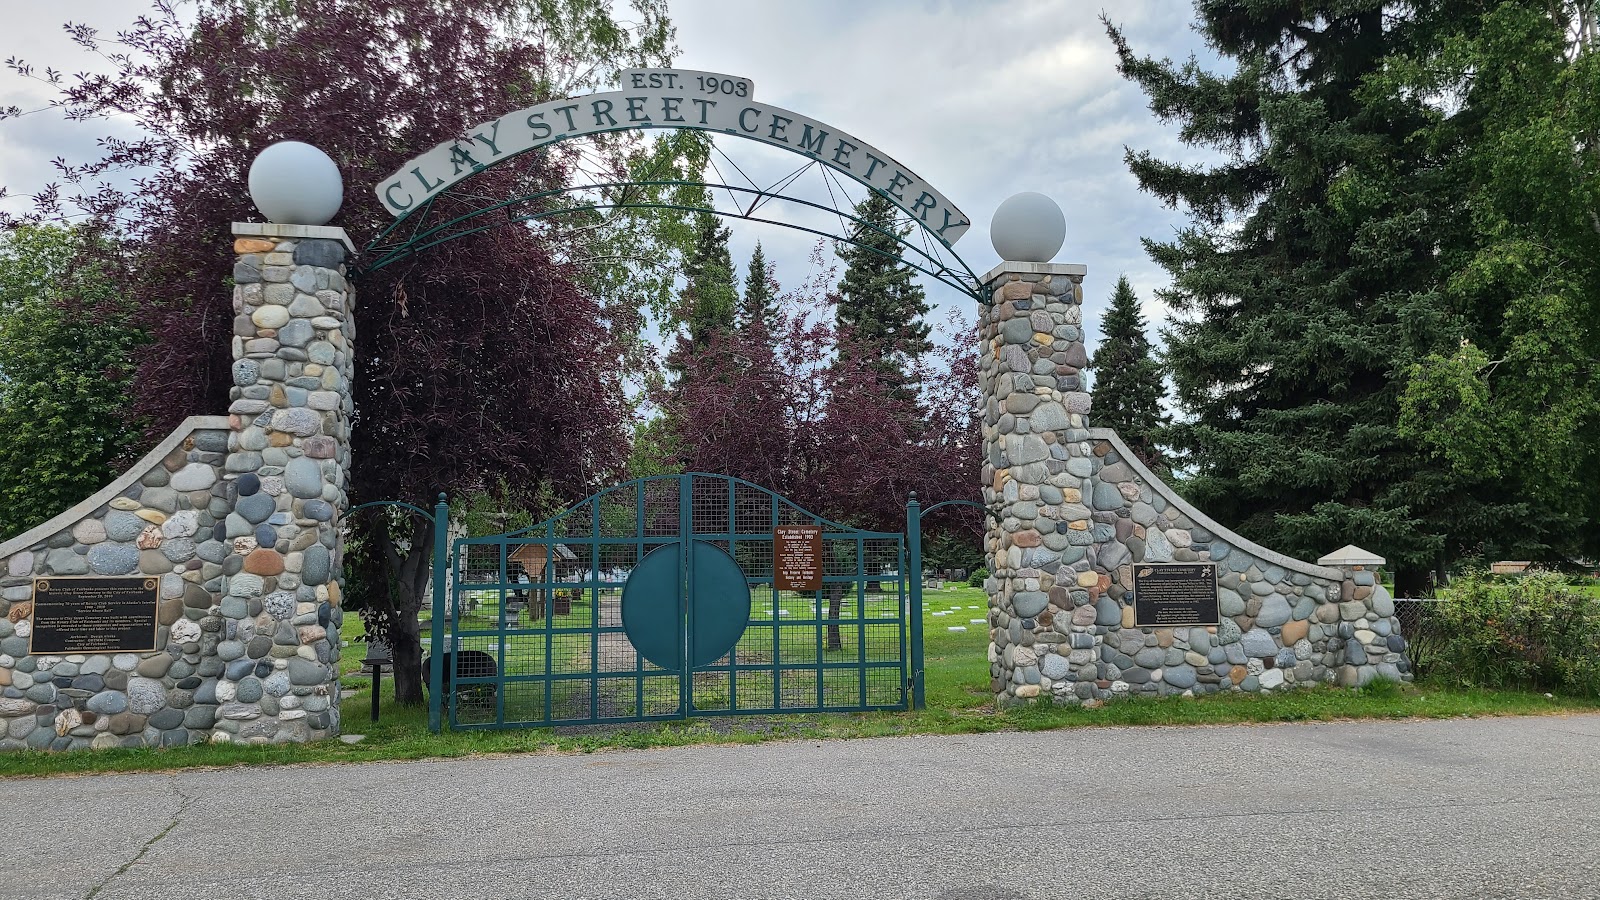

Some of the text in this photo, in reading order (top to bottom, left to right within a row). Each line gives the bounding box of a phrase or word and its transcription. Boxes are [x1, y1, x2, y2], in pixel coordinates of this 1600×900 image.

[630, 72, 749, 98] EST. 1903
[385, 96, 969, 237] CLAY STREET CEMETERY
